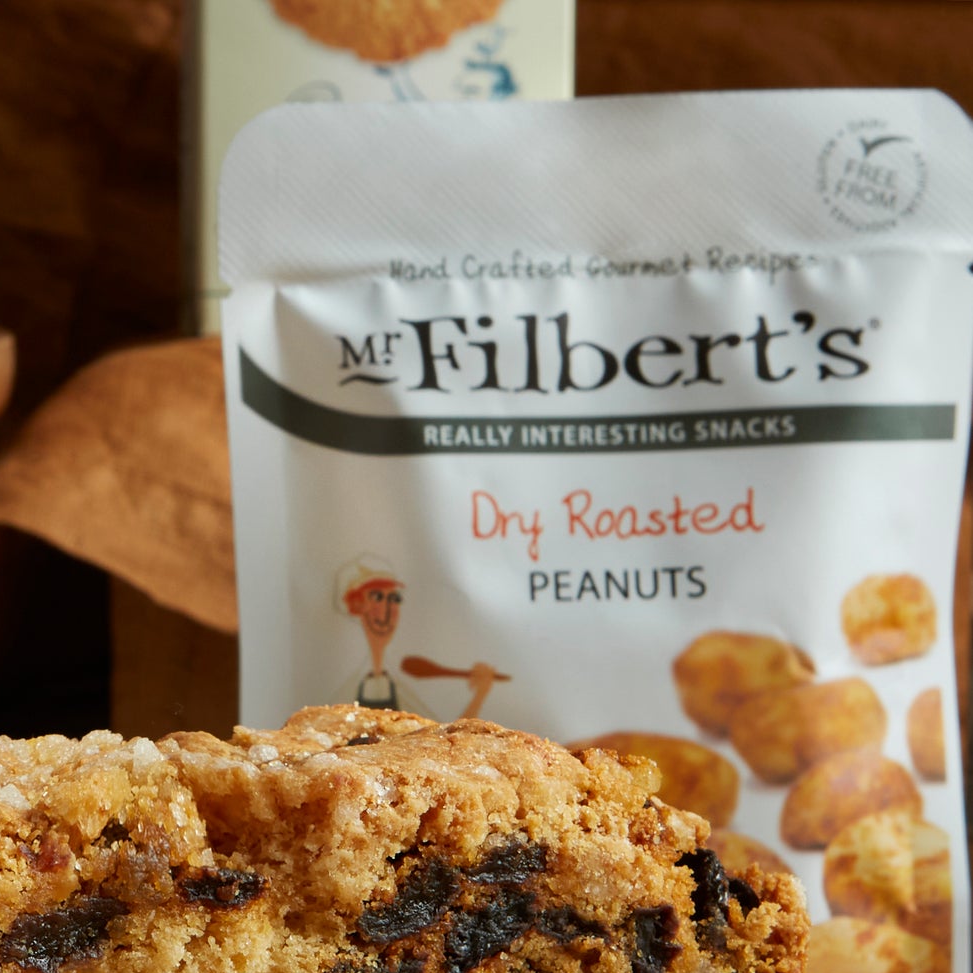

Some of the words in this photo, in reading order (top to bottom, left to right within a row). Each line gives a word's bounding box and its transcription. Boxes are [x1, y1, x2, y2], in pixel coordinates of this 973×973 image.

[388, 257, 450, 282] Hand
[461, 249, 574, 280] Crafted
[585, 253, 697, 279] Gourmet
[399, 311, 871, 395] Filbert's
[423, 424, 514, 447] REALLY
[521, 421, 687, 447] INTERESTING
[694, 414, 797, 442] SNACKS
[471, 490, 543, 563] Dry
[562, 486, 766, 541] Roasted
[529, 565, 708, 602] PEANUTS
